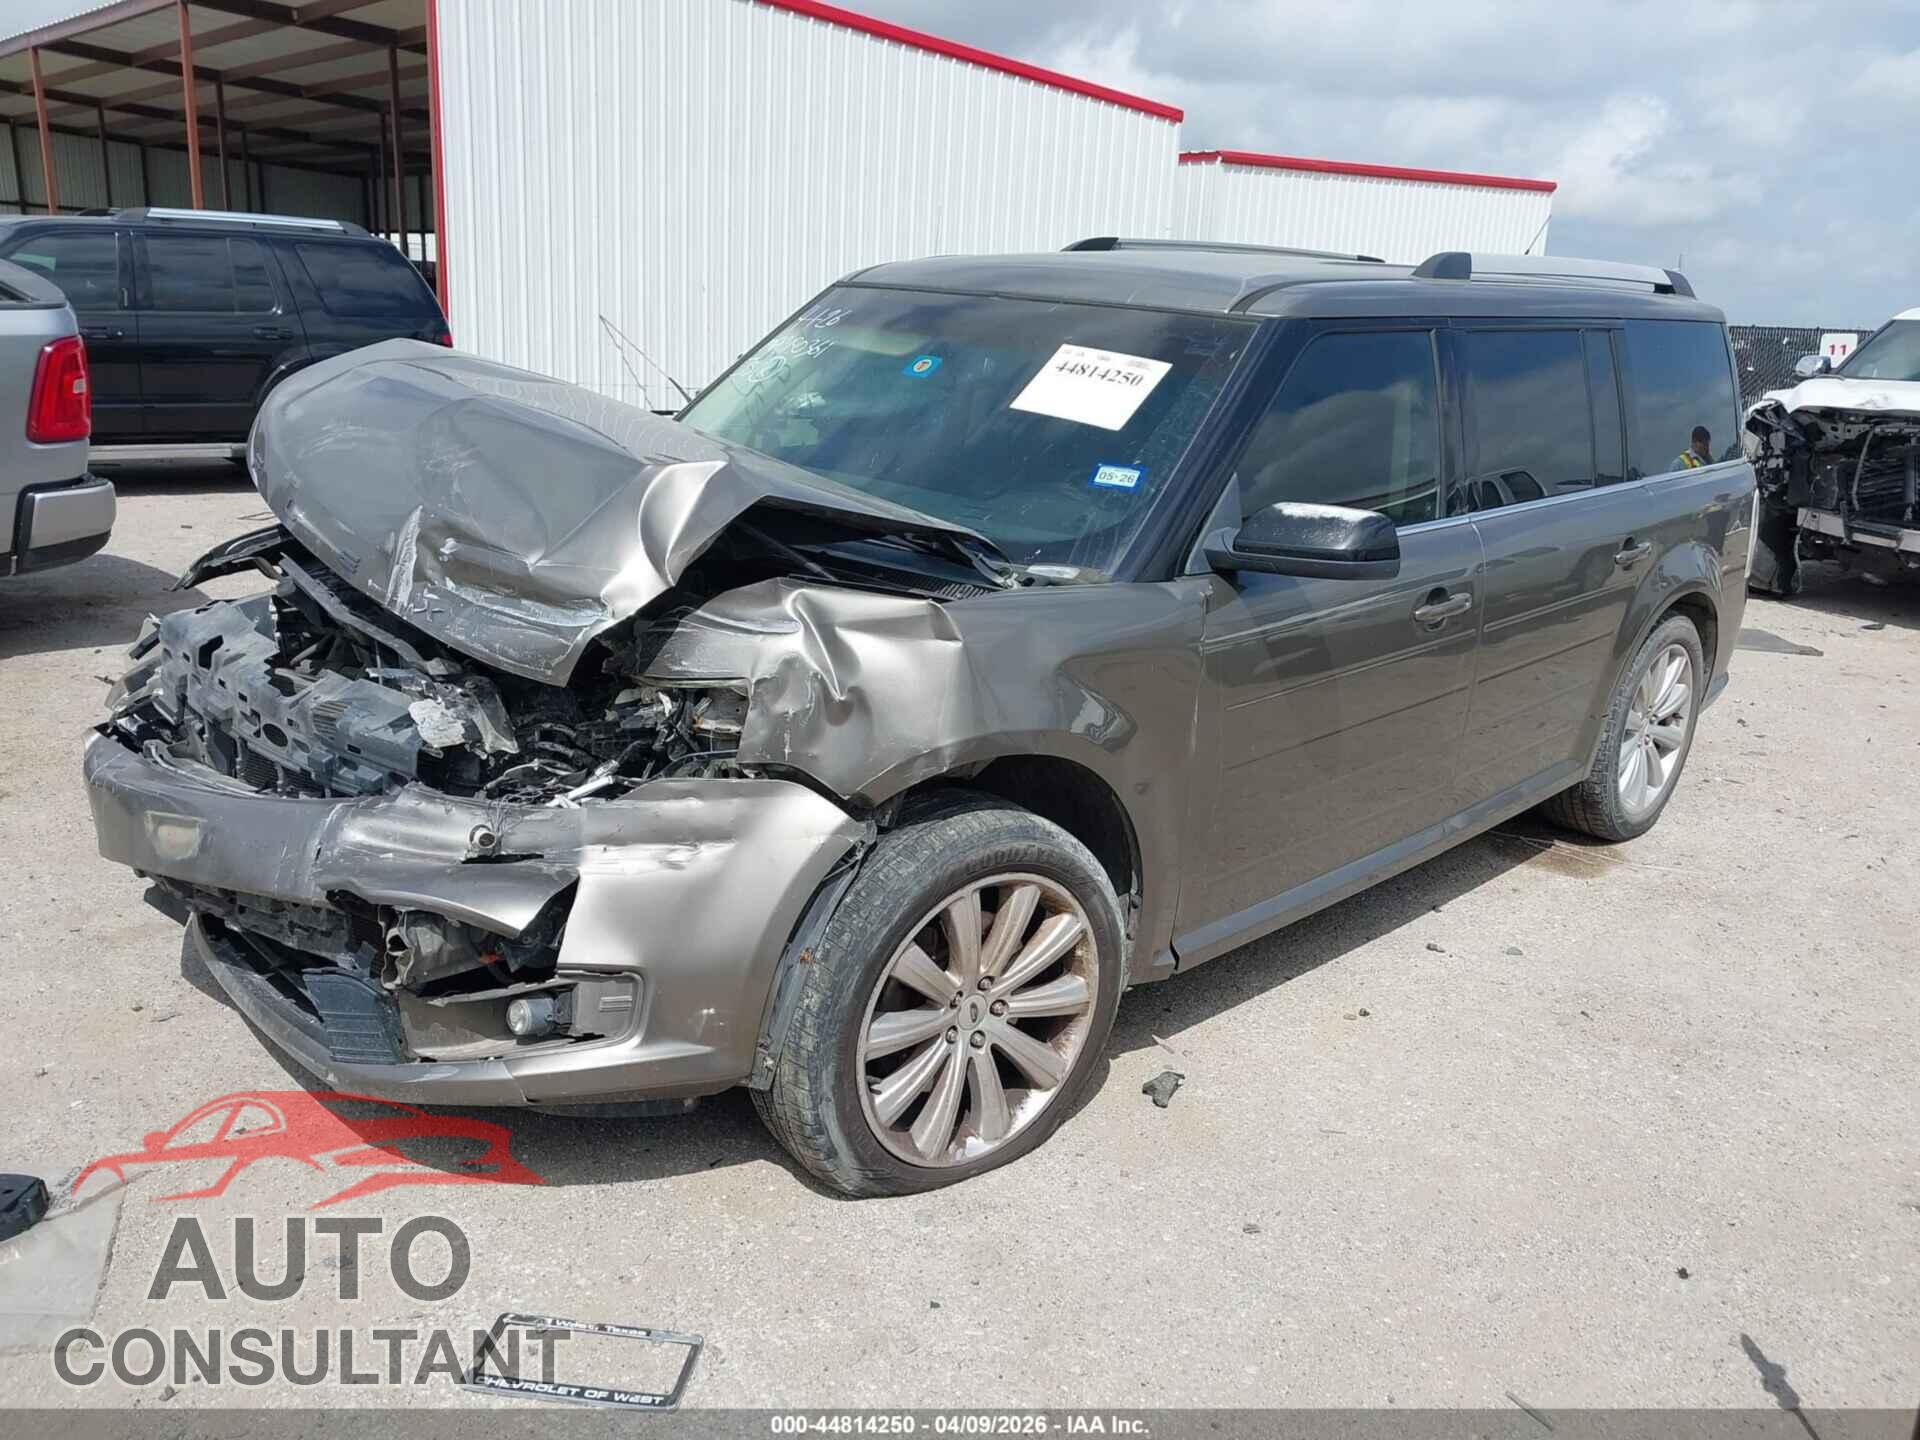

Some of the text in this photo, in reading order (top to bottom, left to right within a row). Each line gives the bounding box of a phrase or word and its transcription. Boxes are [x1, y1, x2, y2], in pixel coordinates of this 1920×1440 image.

[1829, 345, 1847, 356] 11
[1056, 360, 1144, 387] 44814250
[474, 1376, 664, 1404] CHEVROLET OF WEST
